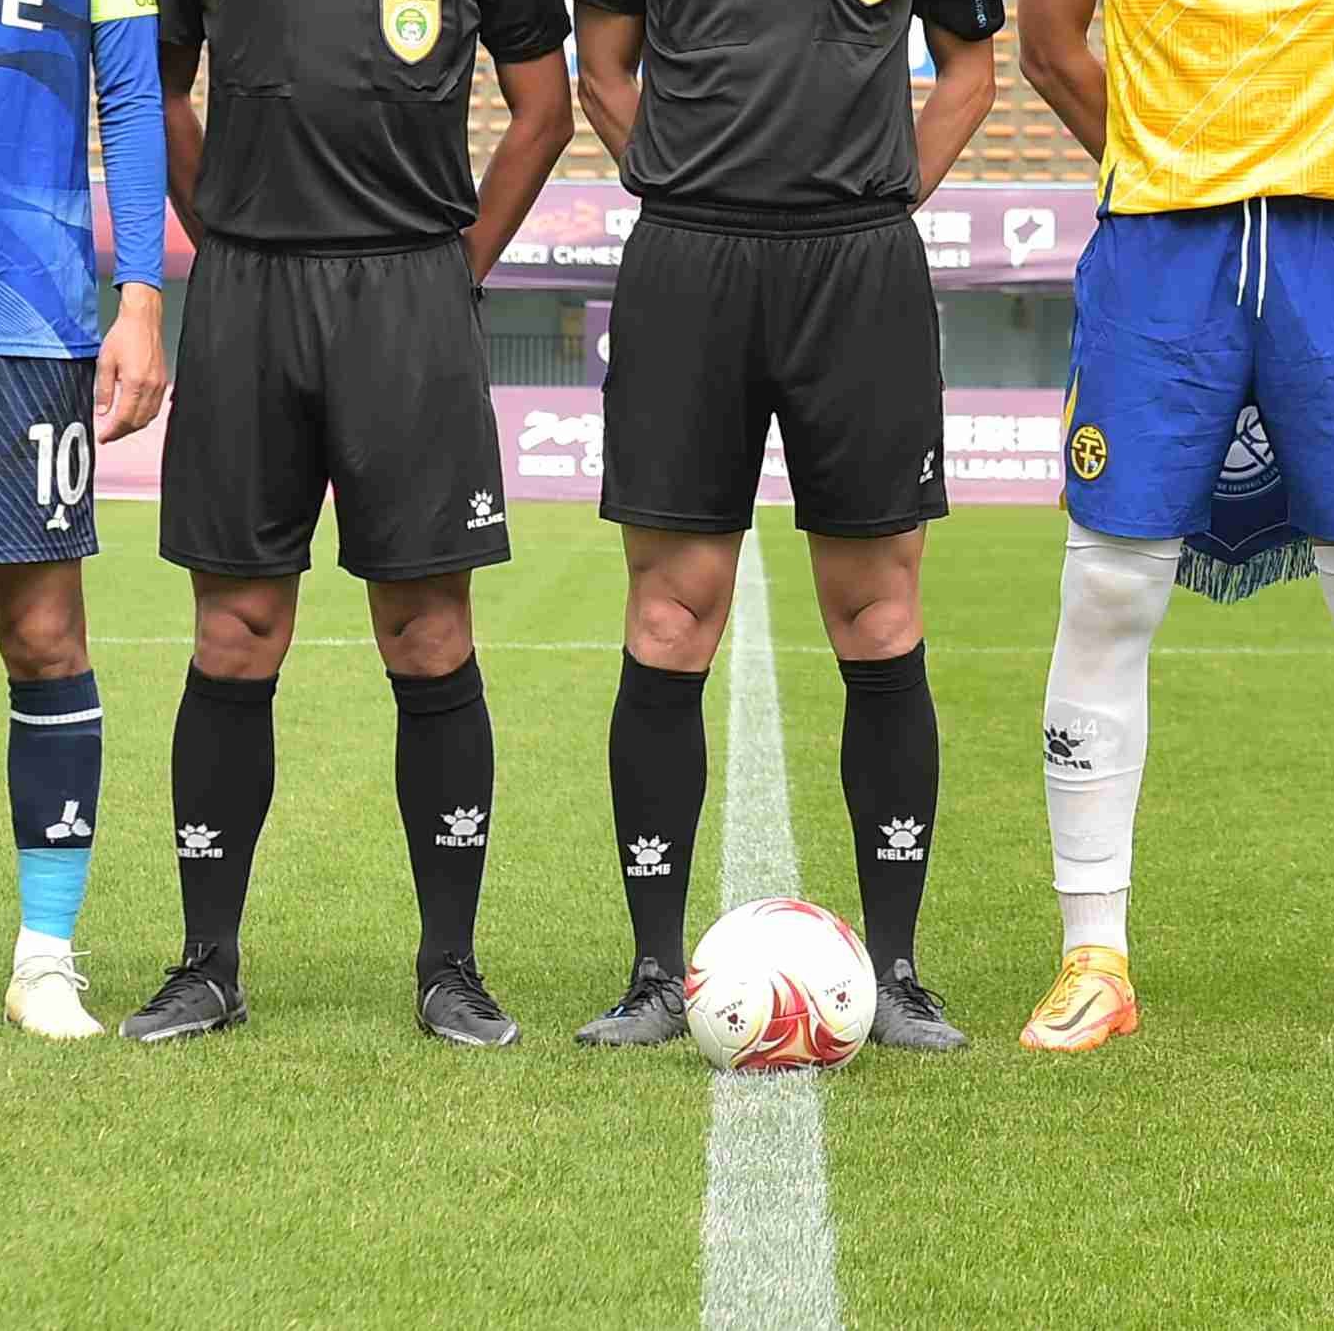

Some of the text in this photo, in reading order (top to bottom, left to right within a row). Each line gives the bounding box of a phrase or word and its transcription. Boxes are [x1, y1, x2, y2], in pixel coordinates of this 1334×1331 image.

[28, 421, 90, 506] 10
[877, 848, 924, 861] KELME
[627, 863, 672, 877] KELME
